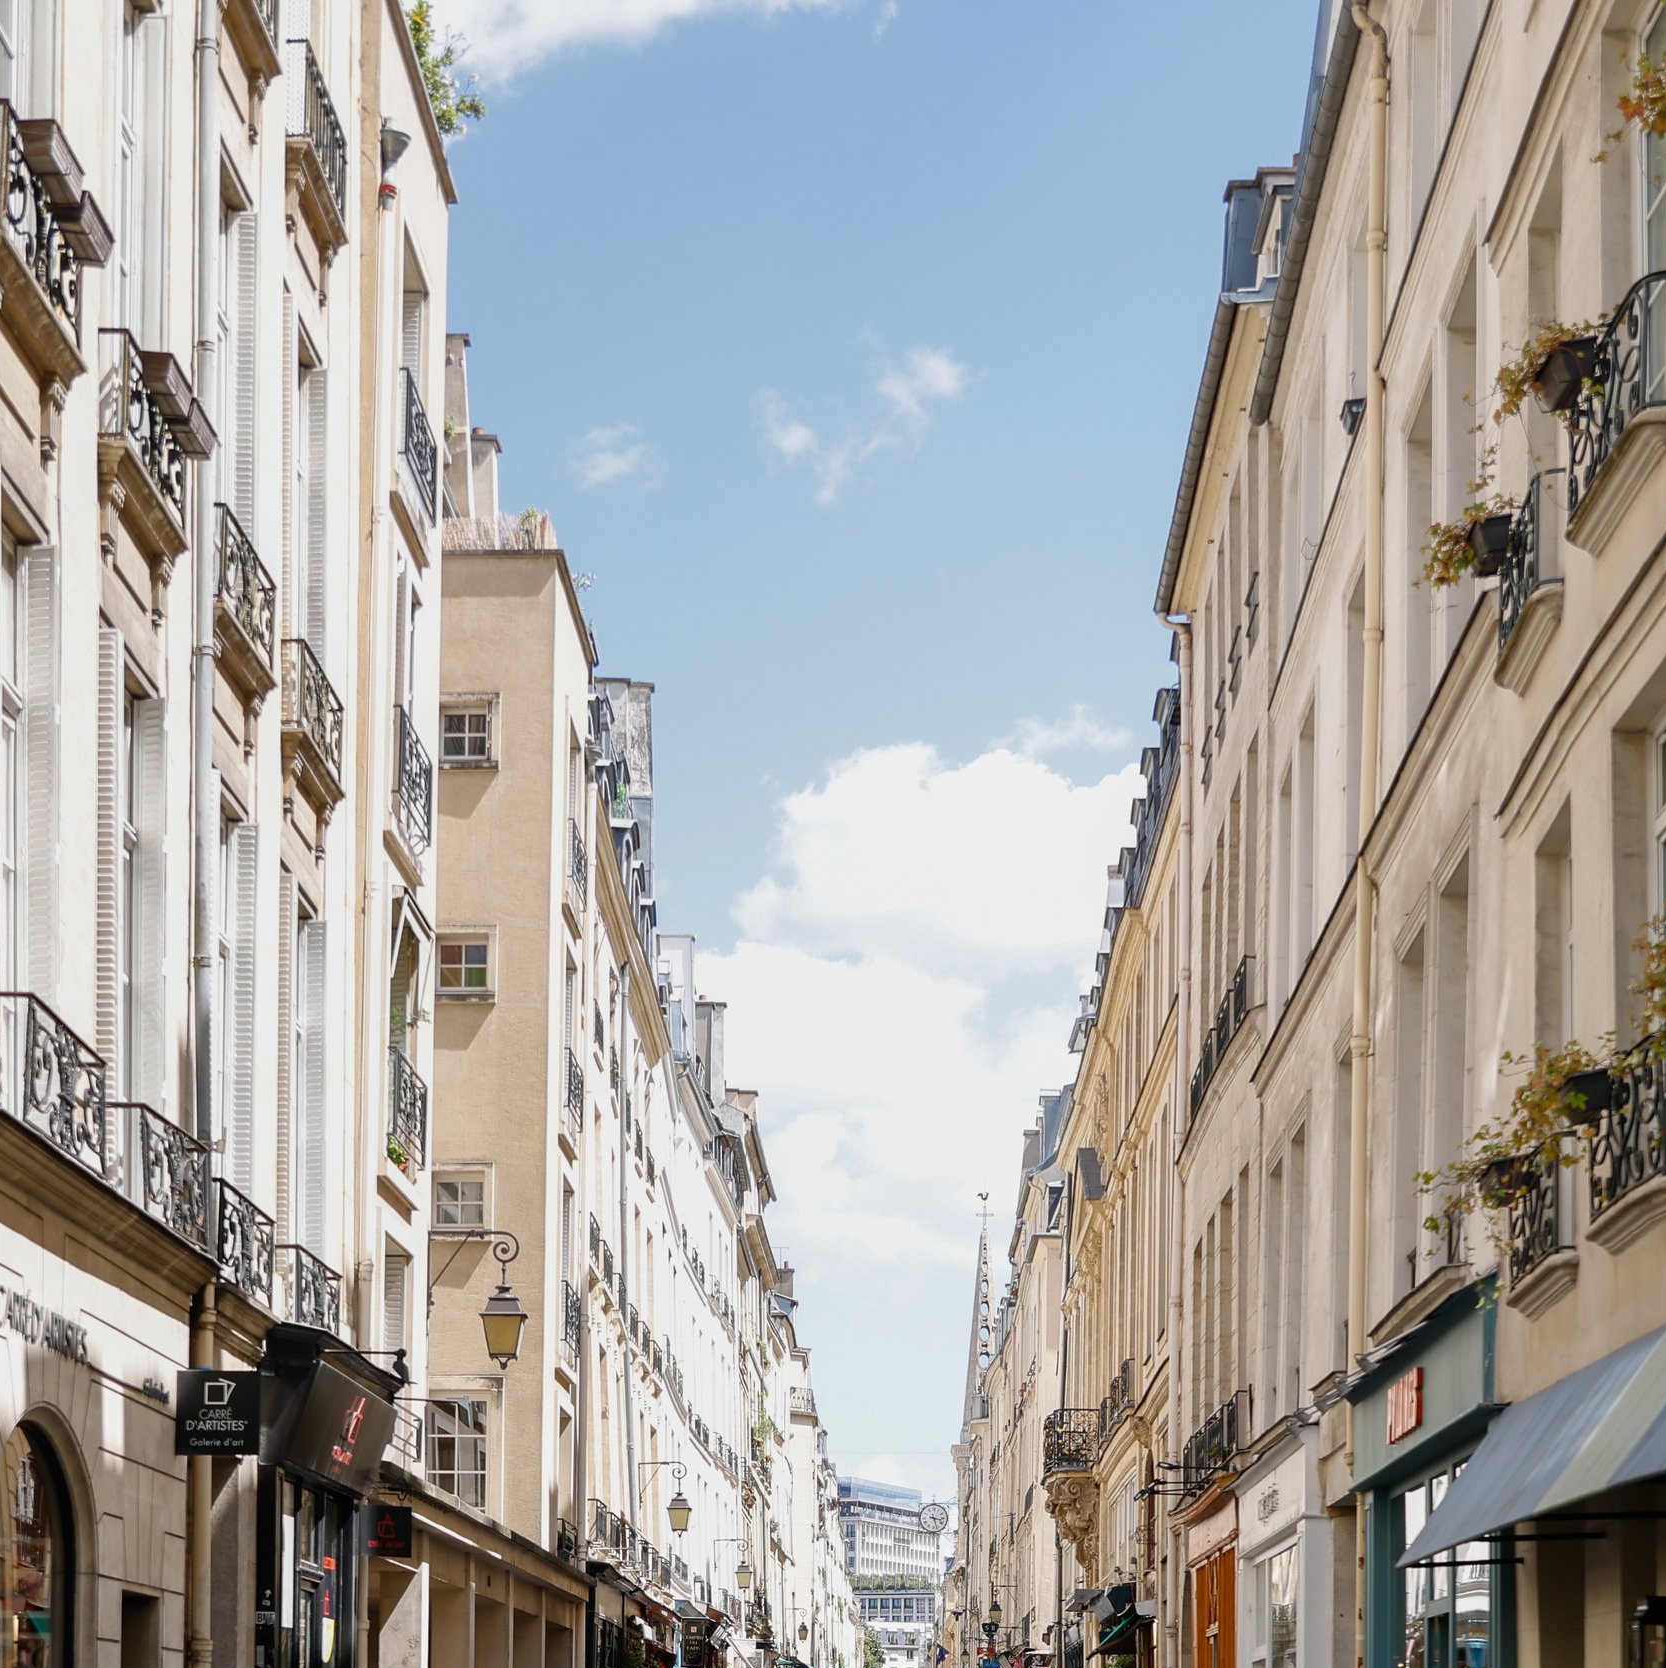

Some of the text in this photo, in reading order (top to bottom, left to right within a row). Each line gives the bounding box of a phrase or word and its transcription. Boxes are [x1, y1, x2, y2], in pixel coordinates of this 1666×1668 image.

[199, 1407, 232, 1420] CARRÉ
[189, 1437, 244, 1447] Galerie d'art
